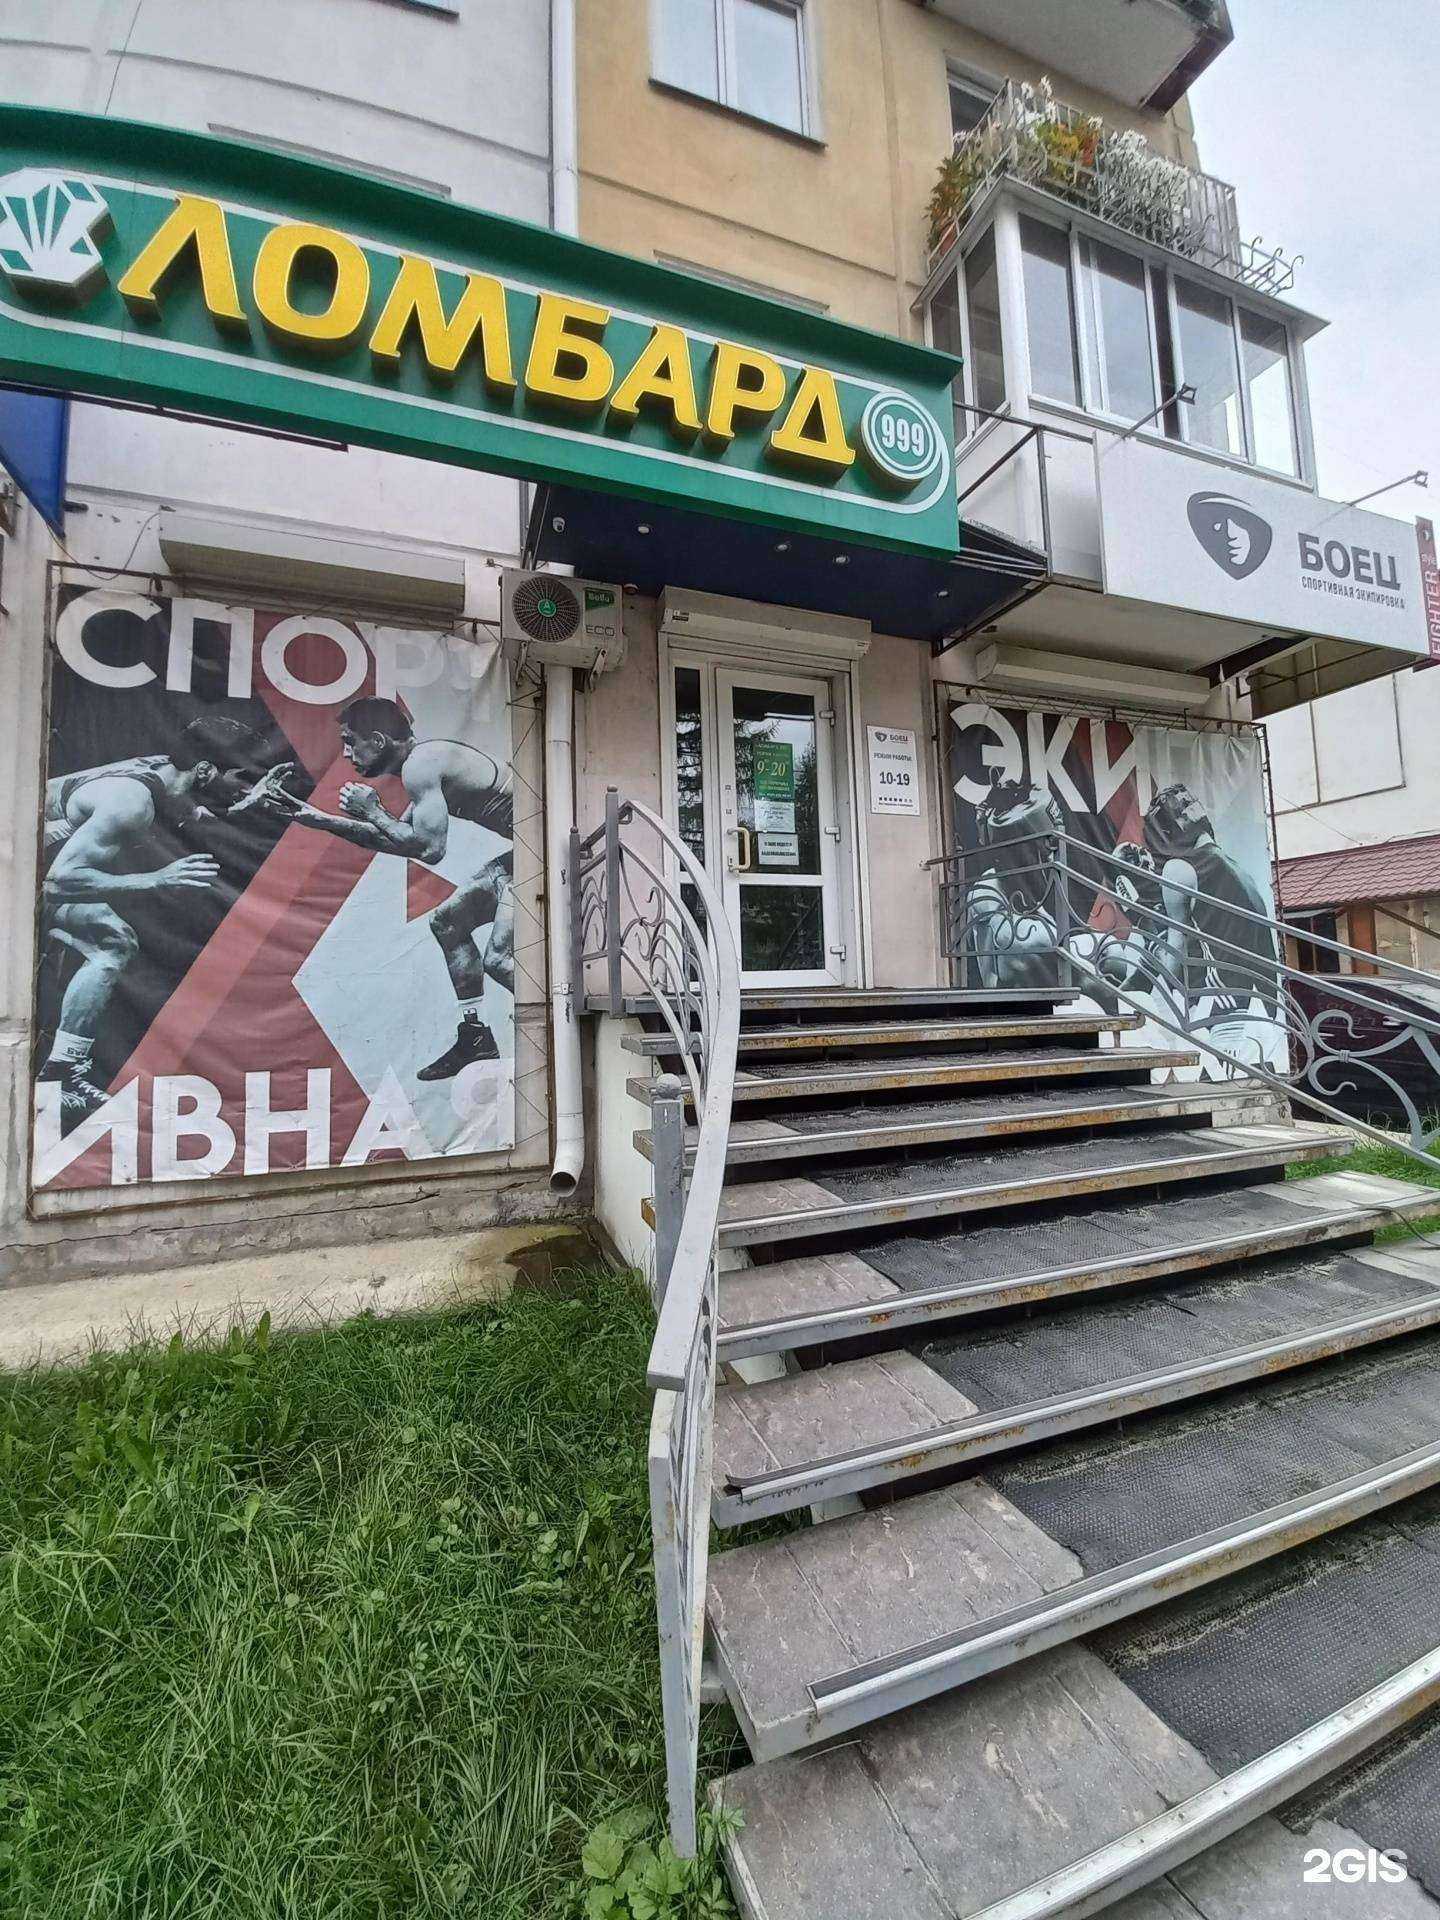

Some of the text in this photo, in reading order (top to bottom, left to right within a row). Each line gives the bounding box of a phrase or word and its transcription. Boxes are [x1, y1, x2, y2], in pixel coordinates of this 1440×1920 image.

[117, 193, 856, 465] ЛОМБАРД
[881, 413, 925, 457] 999
[1298, 532, 1402, 591] БОЕЦ
[1301, 575, 1406, 610] СПОРТИВНАЯ ЭКИПИРОВКА
[880, 771, 910, 786] 10-19
